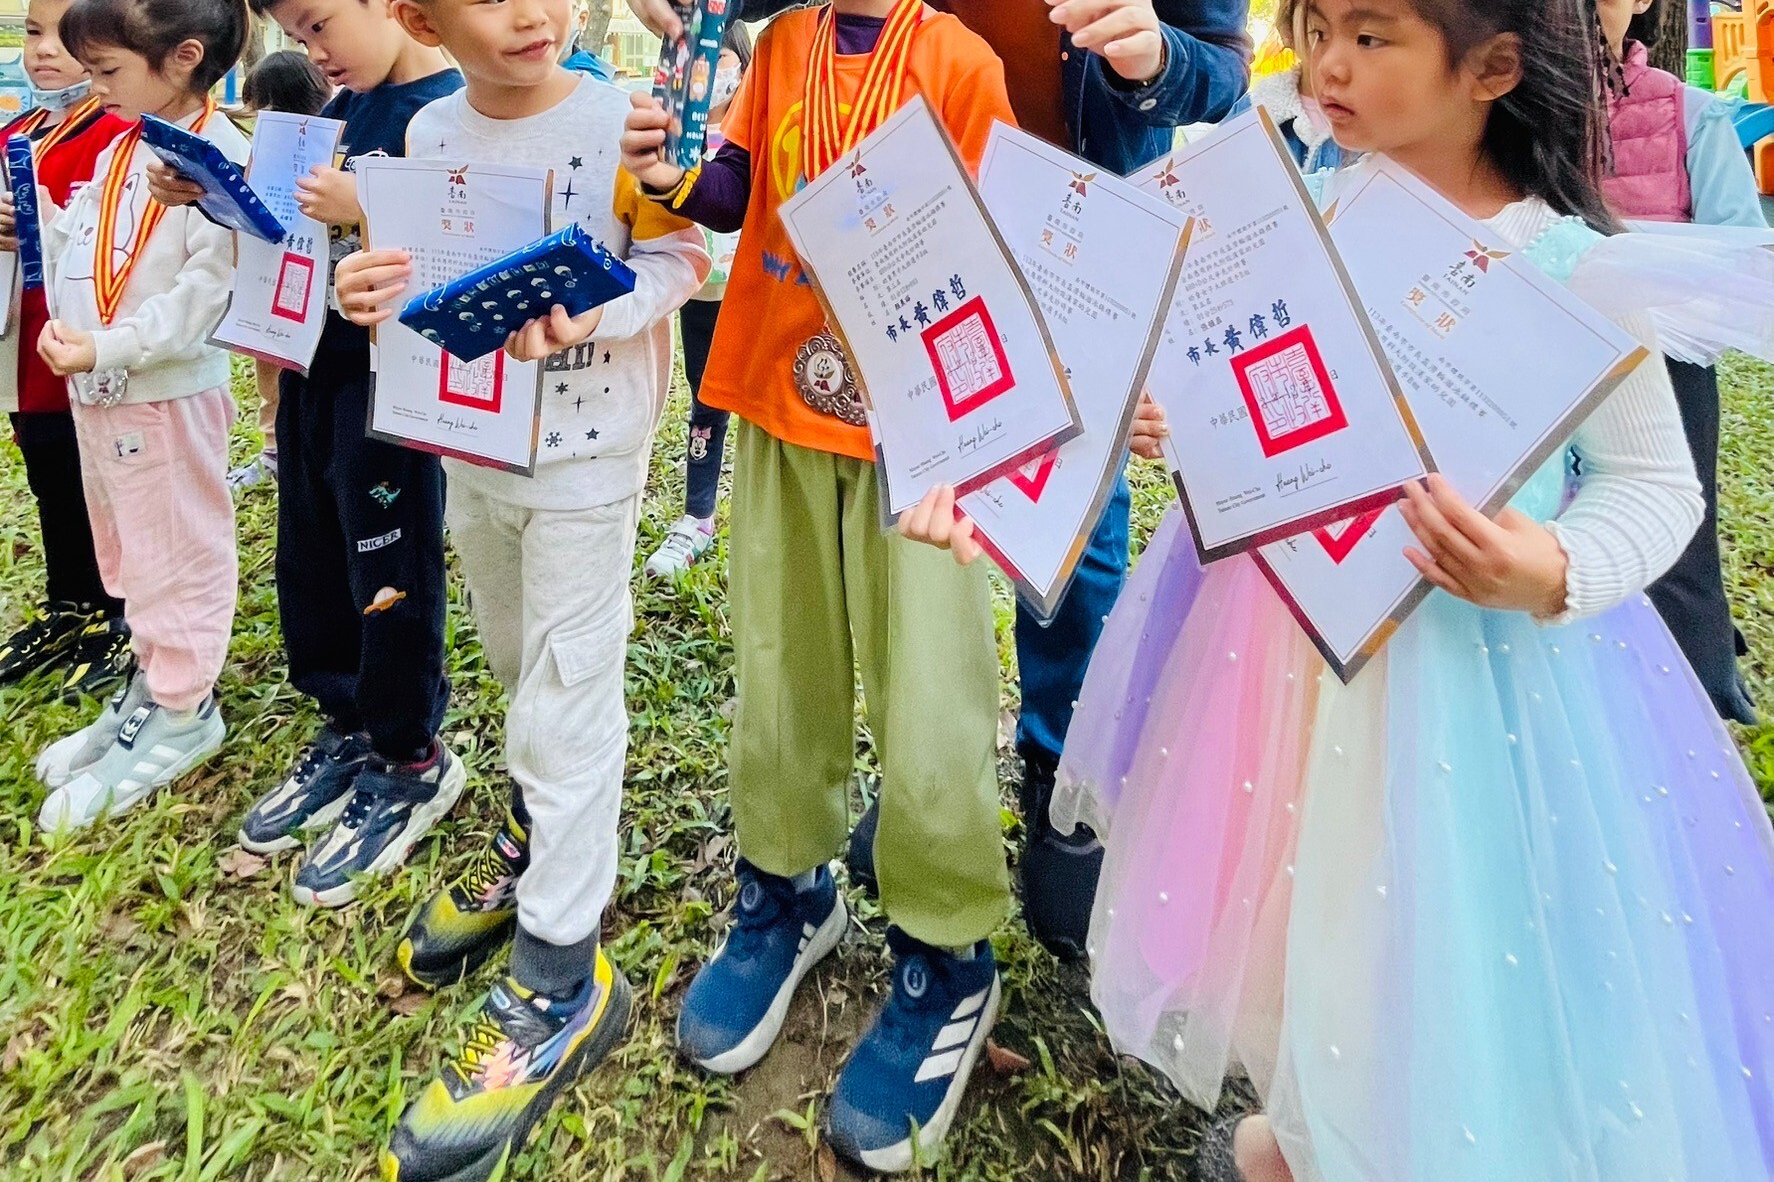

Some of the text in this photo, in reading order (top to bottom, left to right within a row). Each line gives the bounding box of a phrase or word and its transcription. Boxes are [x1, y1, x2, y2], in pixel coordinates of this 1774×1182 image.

[885, 273, 966, 342] 市長黃偉哲
[1187, 299, 1292, 366] 市長黃偉哲
[1209, 406, 1247, 430] 中華民國
[360, 531, 398, 550] NICER
